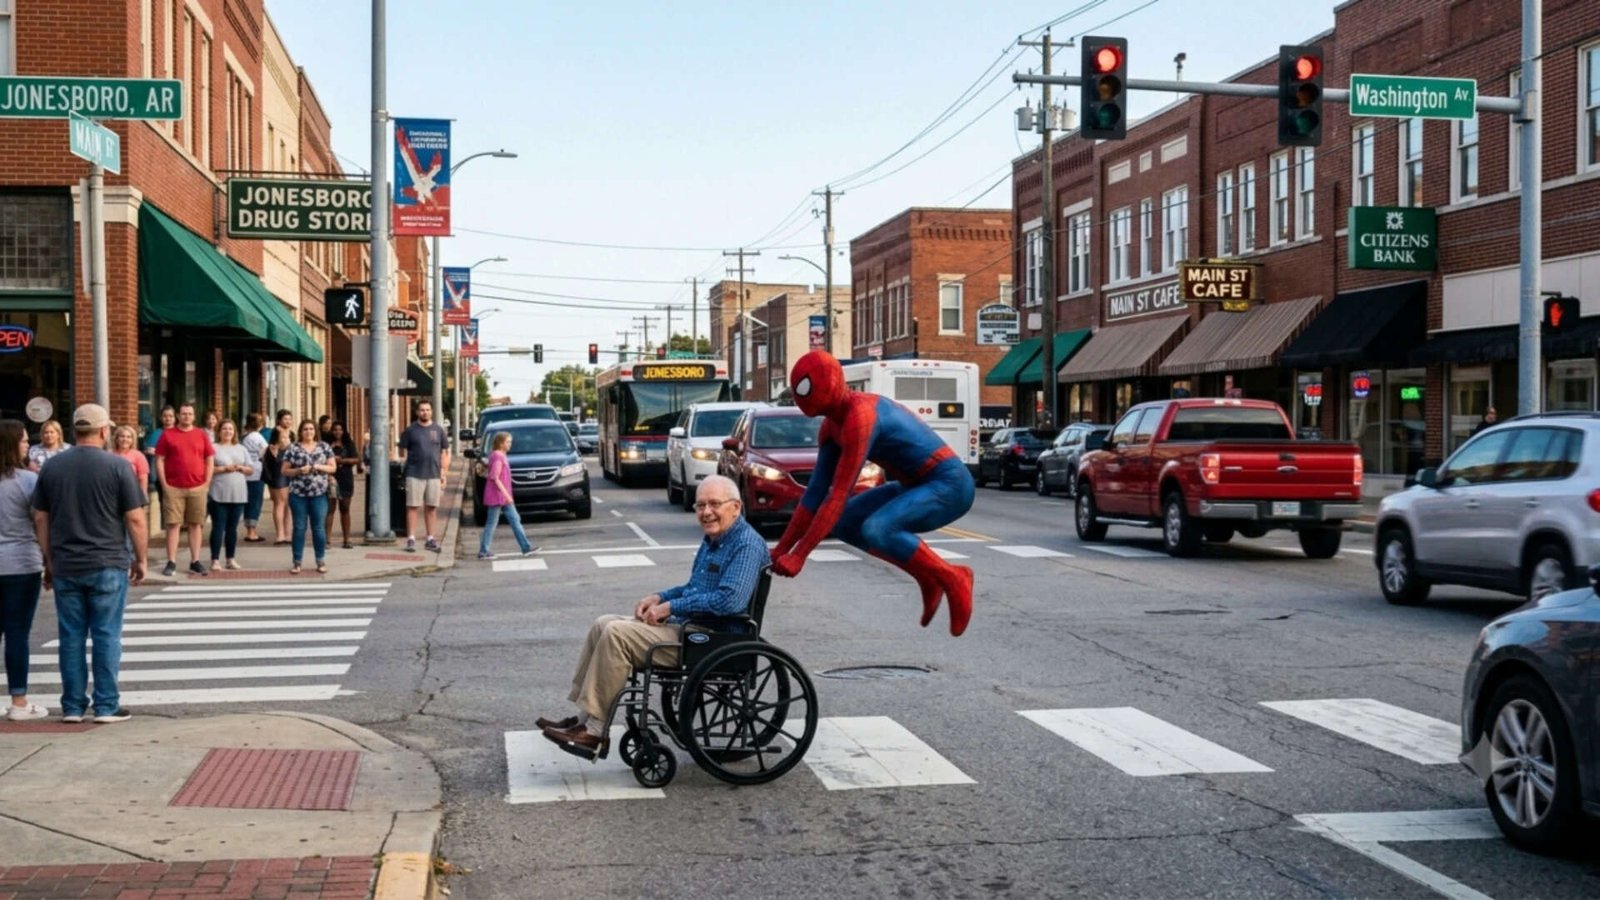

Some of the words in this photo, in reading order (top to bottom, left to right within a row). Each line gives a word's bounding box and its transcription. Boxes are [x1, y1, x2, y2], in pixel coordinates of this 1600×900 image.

[1, 84, 135, 115] JONESBORO,
[145, 87, 174, 113] AR
[1355, 83, 1448, 114] Washington
[75, 121, 102, 161] MAIN
[238, 209, 299, 229] DRUG
[1360, 233, 1430, 248] CITIZENS
[1373, 249, 1416, 263] BANK
[1188, 268, 1226, 282] MAIN
[1230, 269, 1248, 281] ST
[1192, 283, 1242, 298] CAFE
[1110, 295, 1134, 316] MAIN
[1136, 291, 1150, 311] ST
[1153, 284, 1180, 308] CAFE
[0, 331, 30, 347] PEN
